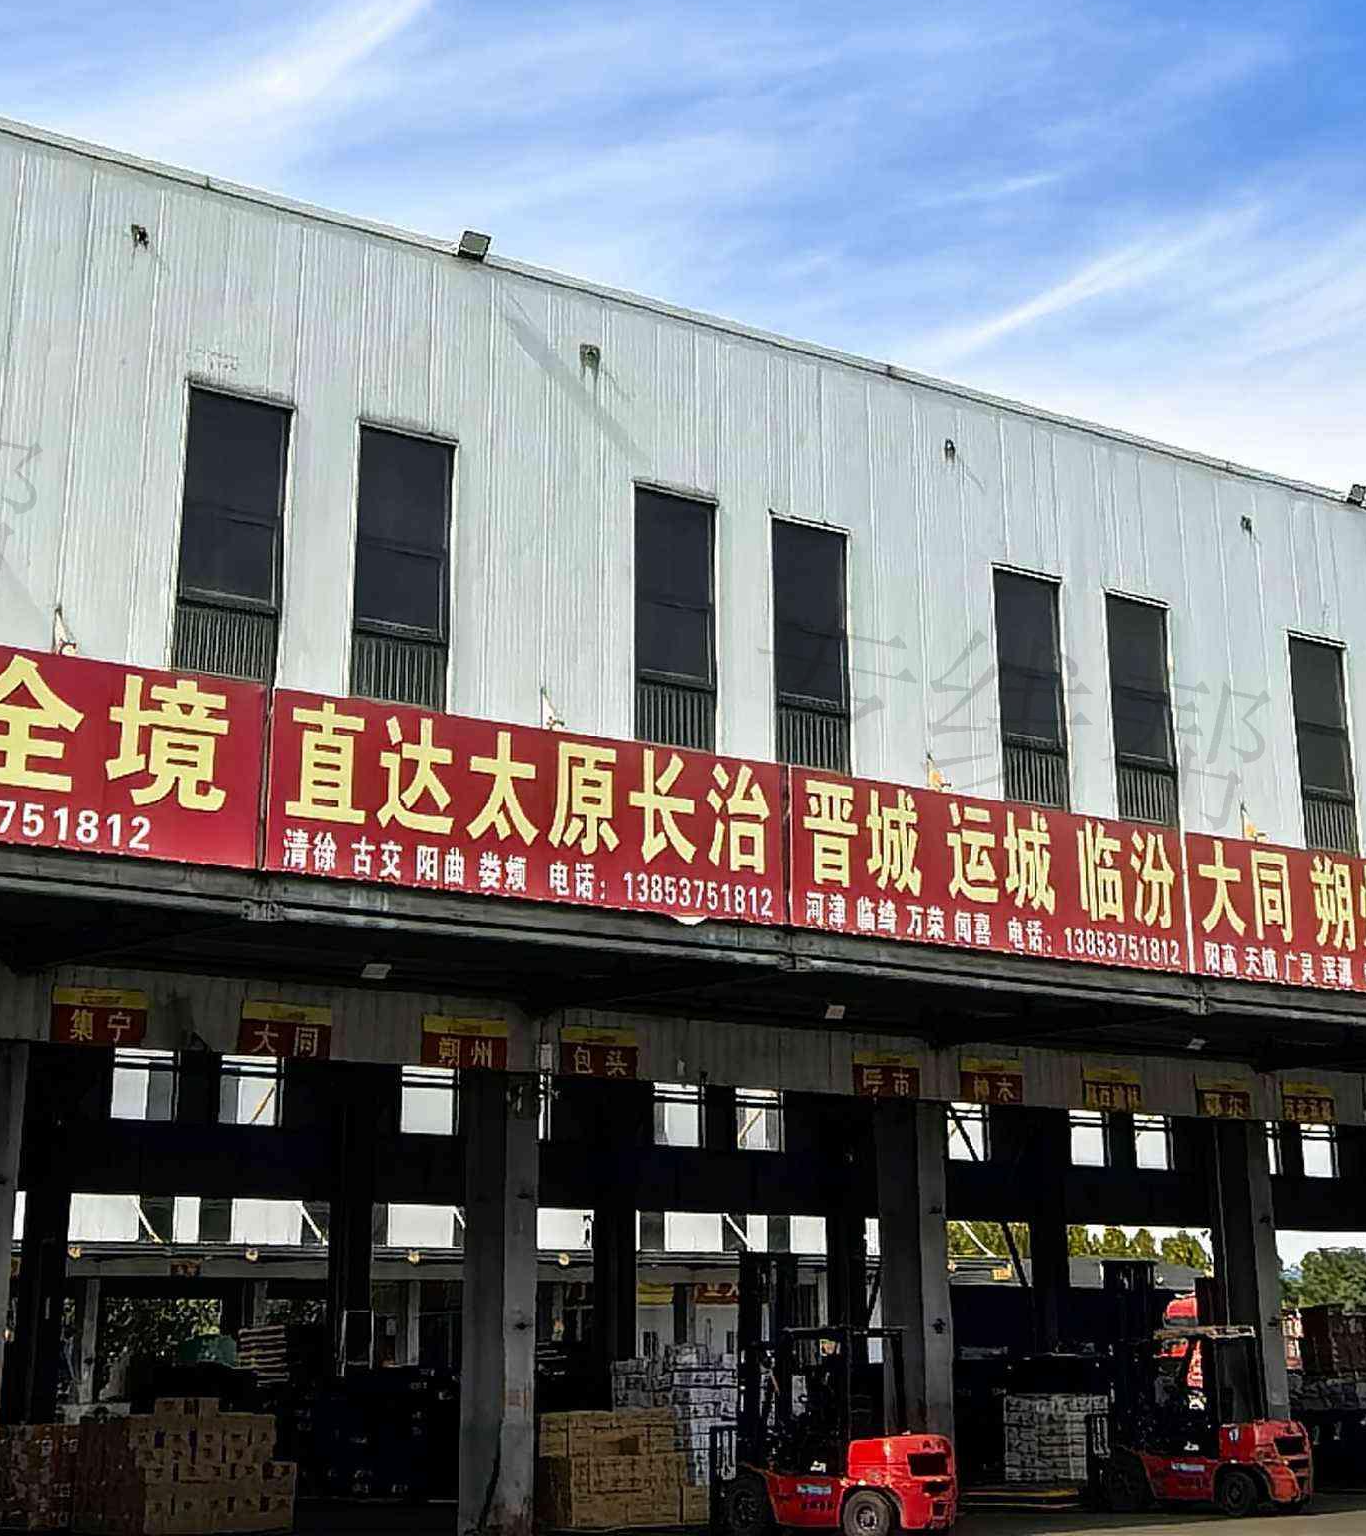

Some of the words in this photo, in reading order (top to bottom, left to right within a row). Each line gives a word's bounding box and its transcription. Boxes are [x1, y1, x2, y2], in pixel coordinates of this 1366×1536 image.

[284, 702, 769, 874] 直达太原长治
[283, 828, 336, 871] 清徐
[350, 836, 403, 879] 古交
[416, 845, 464, 885] 阳曲
[623, 871, 773, 918] 13853751812
[803, 779, 922, 896] 晋城
[947, 801, 1056, 915] 运城
[1078, 820, 1175, 928] 临汾
[1198, 840, 1293, 943] 大同
[906, 905, 945, 939] 万荣
[1064, 927, 1181, 965] 13853751812
[251, 1023, 319, 1057] 大同
